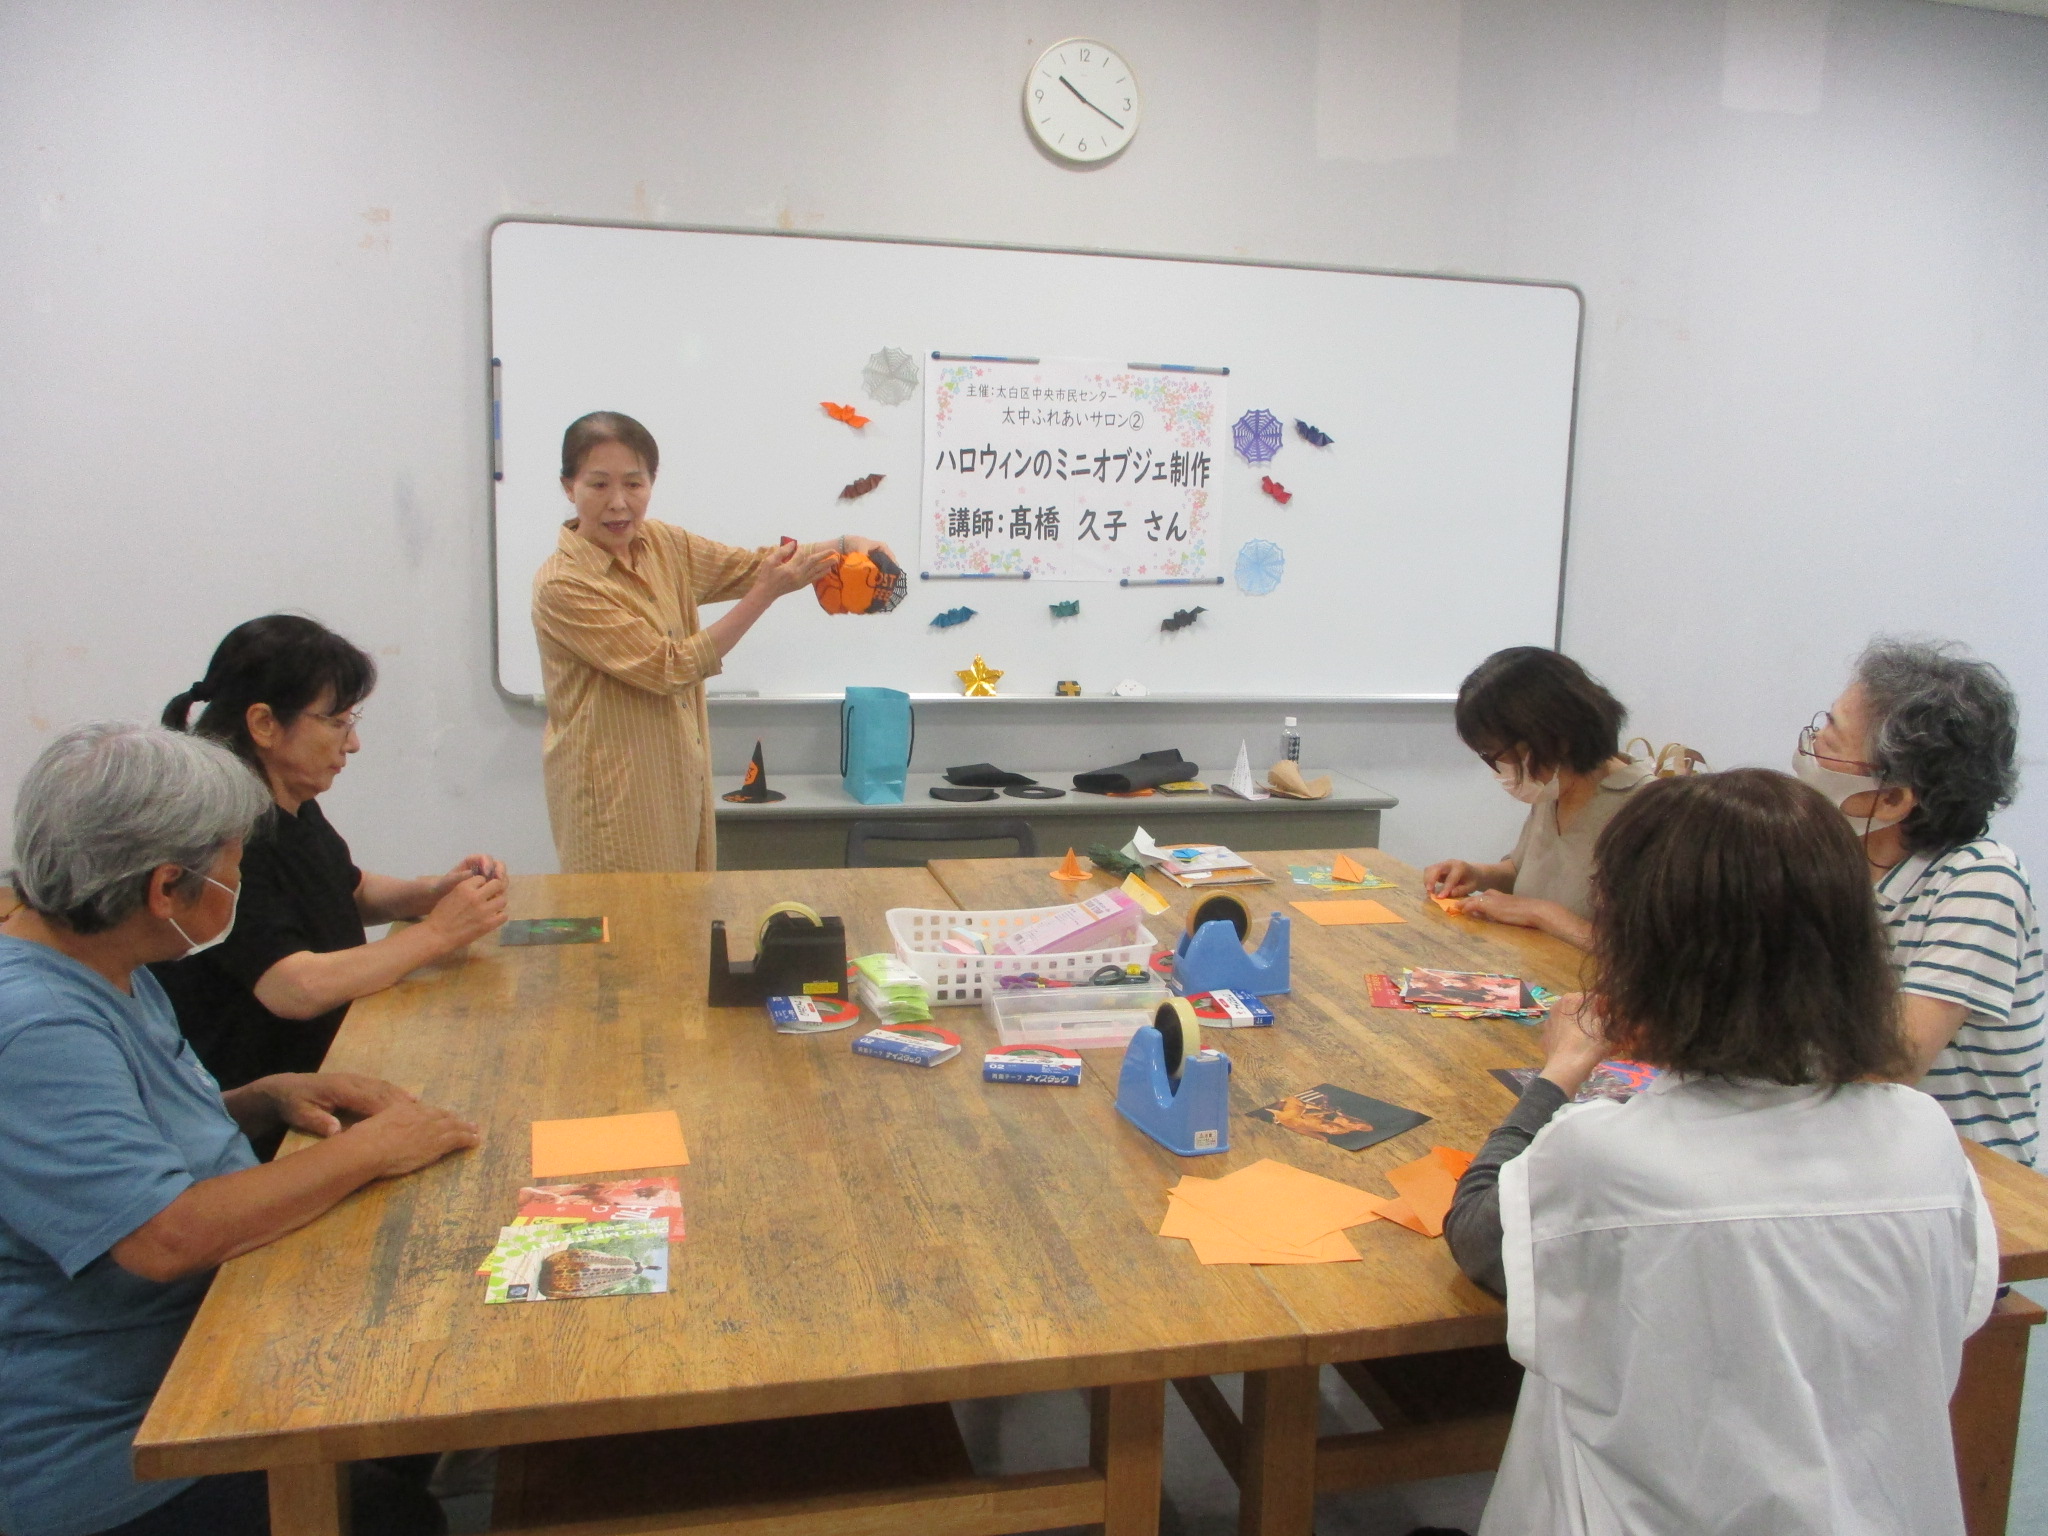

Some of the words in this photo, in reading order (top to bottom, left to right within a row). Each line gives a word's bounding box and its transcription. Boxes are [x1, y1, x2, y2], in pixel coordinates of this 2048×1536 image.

[1080, 48, 1090, 62] 12
[1035, 89, 1044, 104] 9
[1123, 98, 1131, 111] 3
[1078, 138, 1087, 152] 6
[1001, 406, 1144, 431] 太中ふれあいサロン②
[935, 443, 1211, 488] ハロウィンのミニオブジェ制作
[1077, 508, 1127, 541] 久子
[1143, 510, 1188, 542] さん
[1026, 1074, 1070, 1084] ナイスタック
